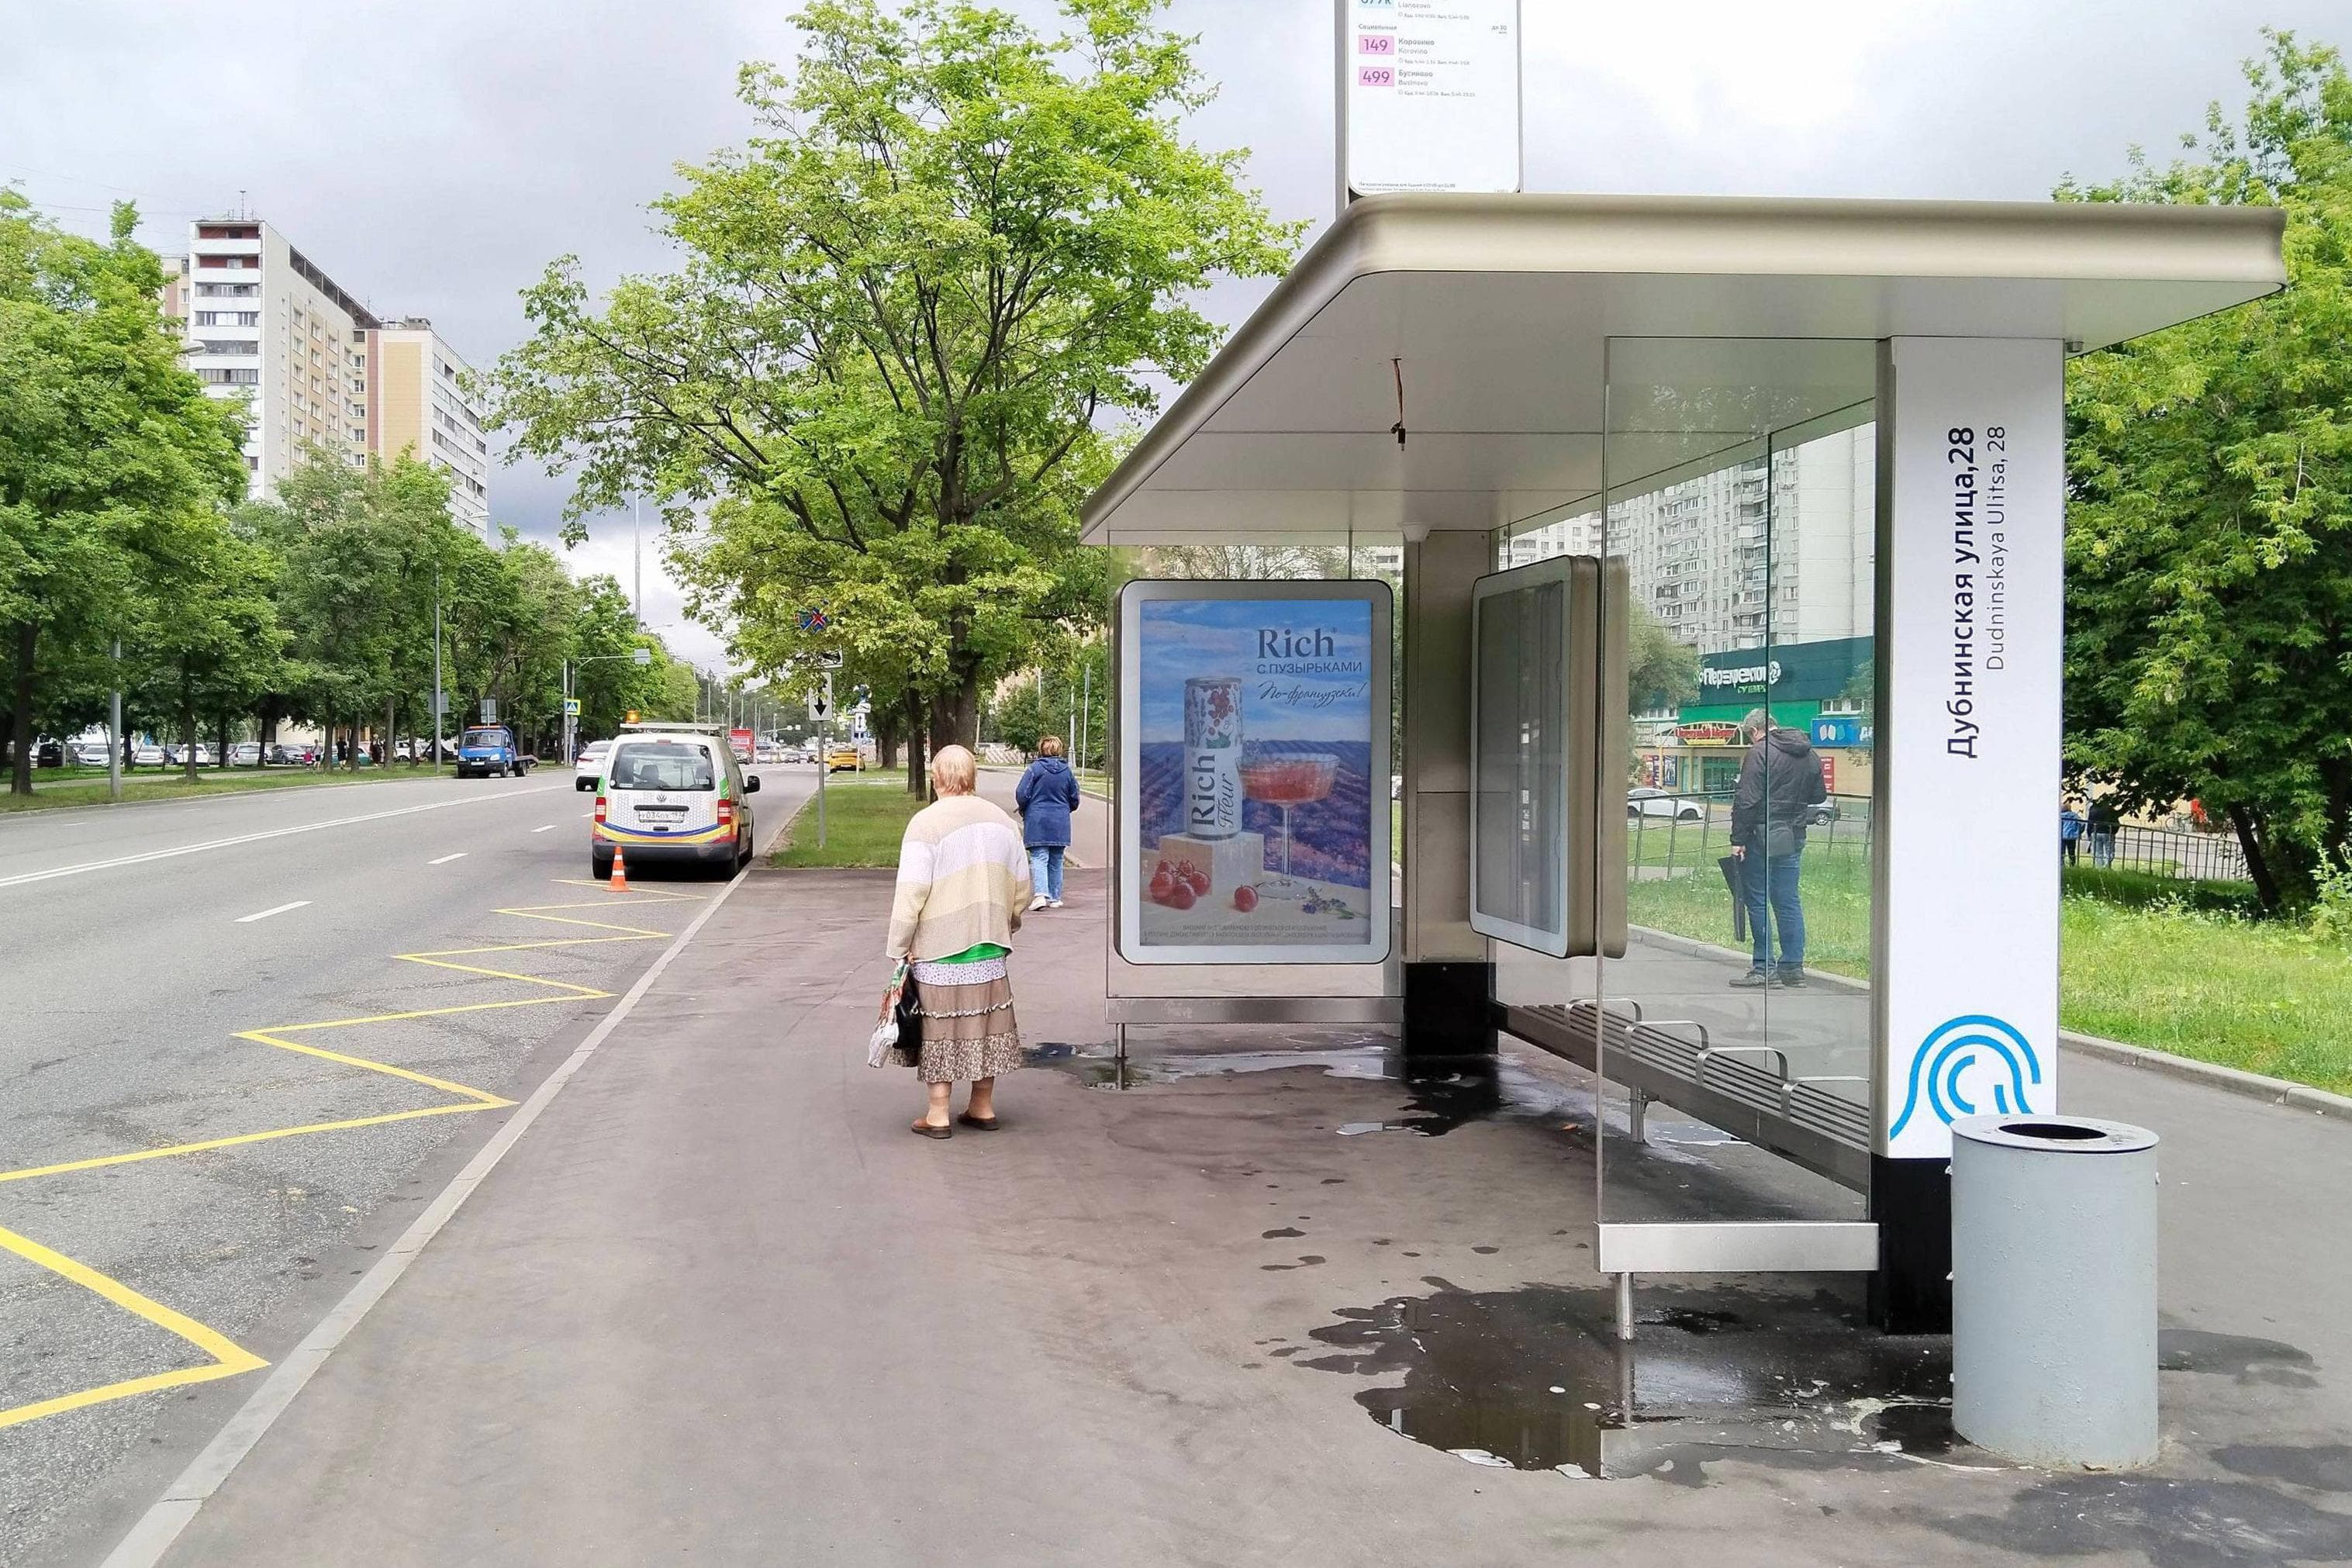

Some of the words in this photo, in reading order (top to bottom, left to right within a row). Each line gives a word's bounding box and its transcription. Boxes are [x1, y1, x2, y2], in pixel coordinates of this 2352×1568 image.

[1364, 39, 1388, 51] 149
[1363, 71, 1390, 83] 499
[1987, 426, 2006, 452] 28
[1986, 458, 2008, 525] Ulitsa,
[1986, 532, 2008, 671] Dudninskaya
[1257, 628, 1335, 659] Rich
[1256, 664, 1266, 675] С
[1269, 661, 1363, 675] ПУЗЫРЬКАМИ
[1946, 574, 1980, 759] Дубнинская
[1191, 755, 1215, 827] Rich
[1217, 772, 1235, 828] Fleur
